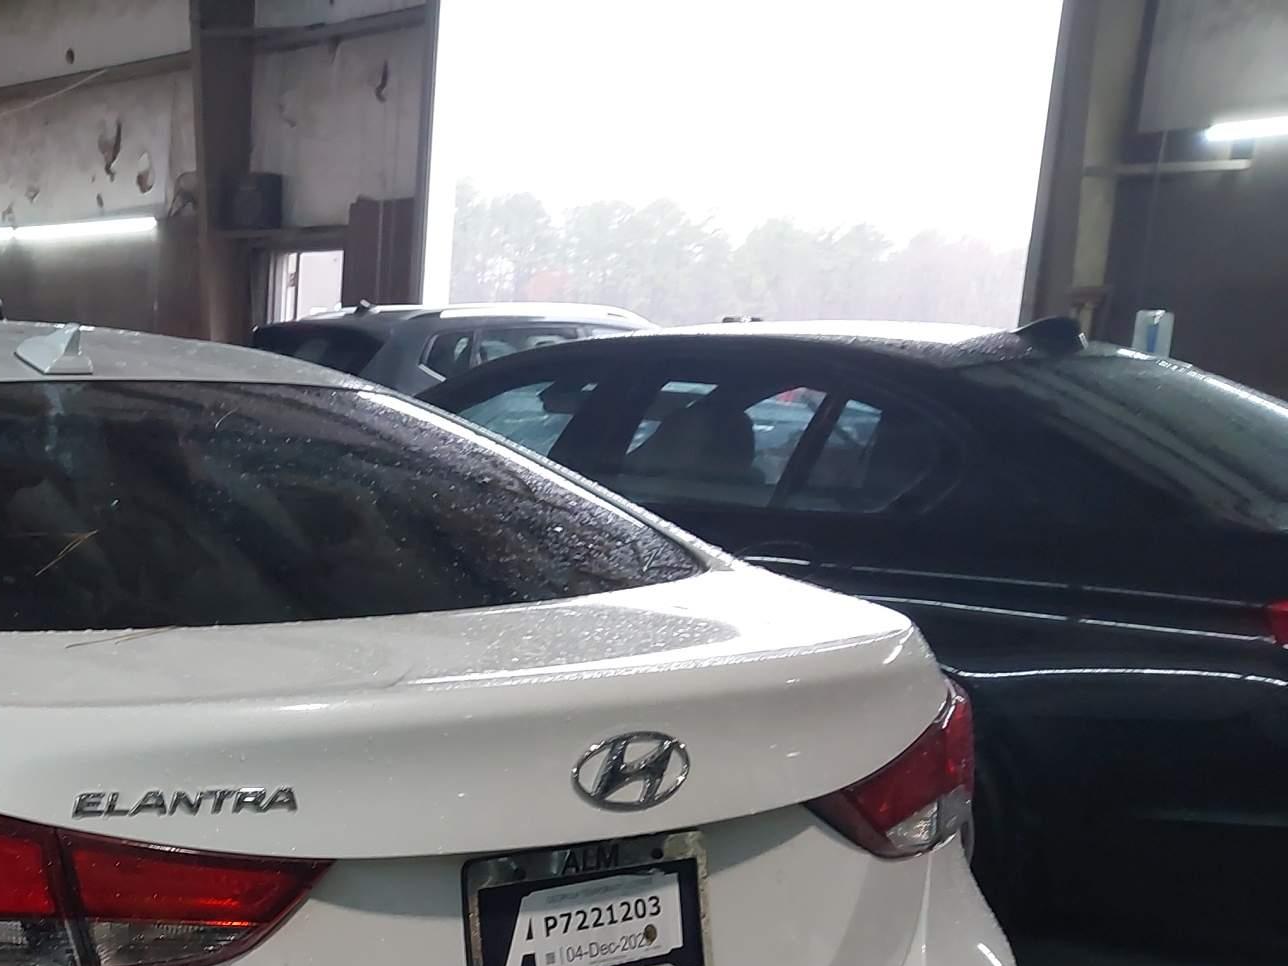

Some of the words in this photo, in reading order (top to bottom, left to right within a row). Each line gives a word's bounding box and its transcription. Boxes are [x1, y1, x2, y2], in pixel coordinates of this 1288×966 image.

[71, 787, 298, 819] ELANTRA
[562, 843, 619, 876] ALM
[544, 895, 661, 938] P7221203
[565, 929, 654, 964] 04-Dec-202
